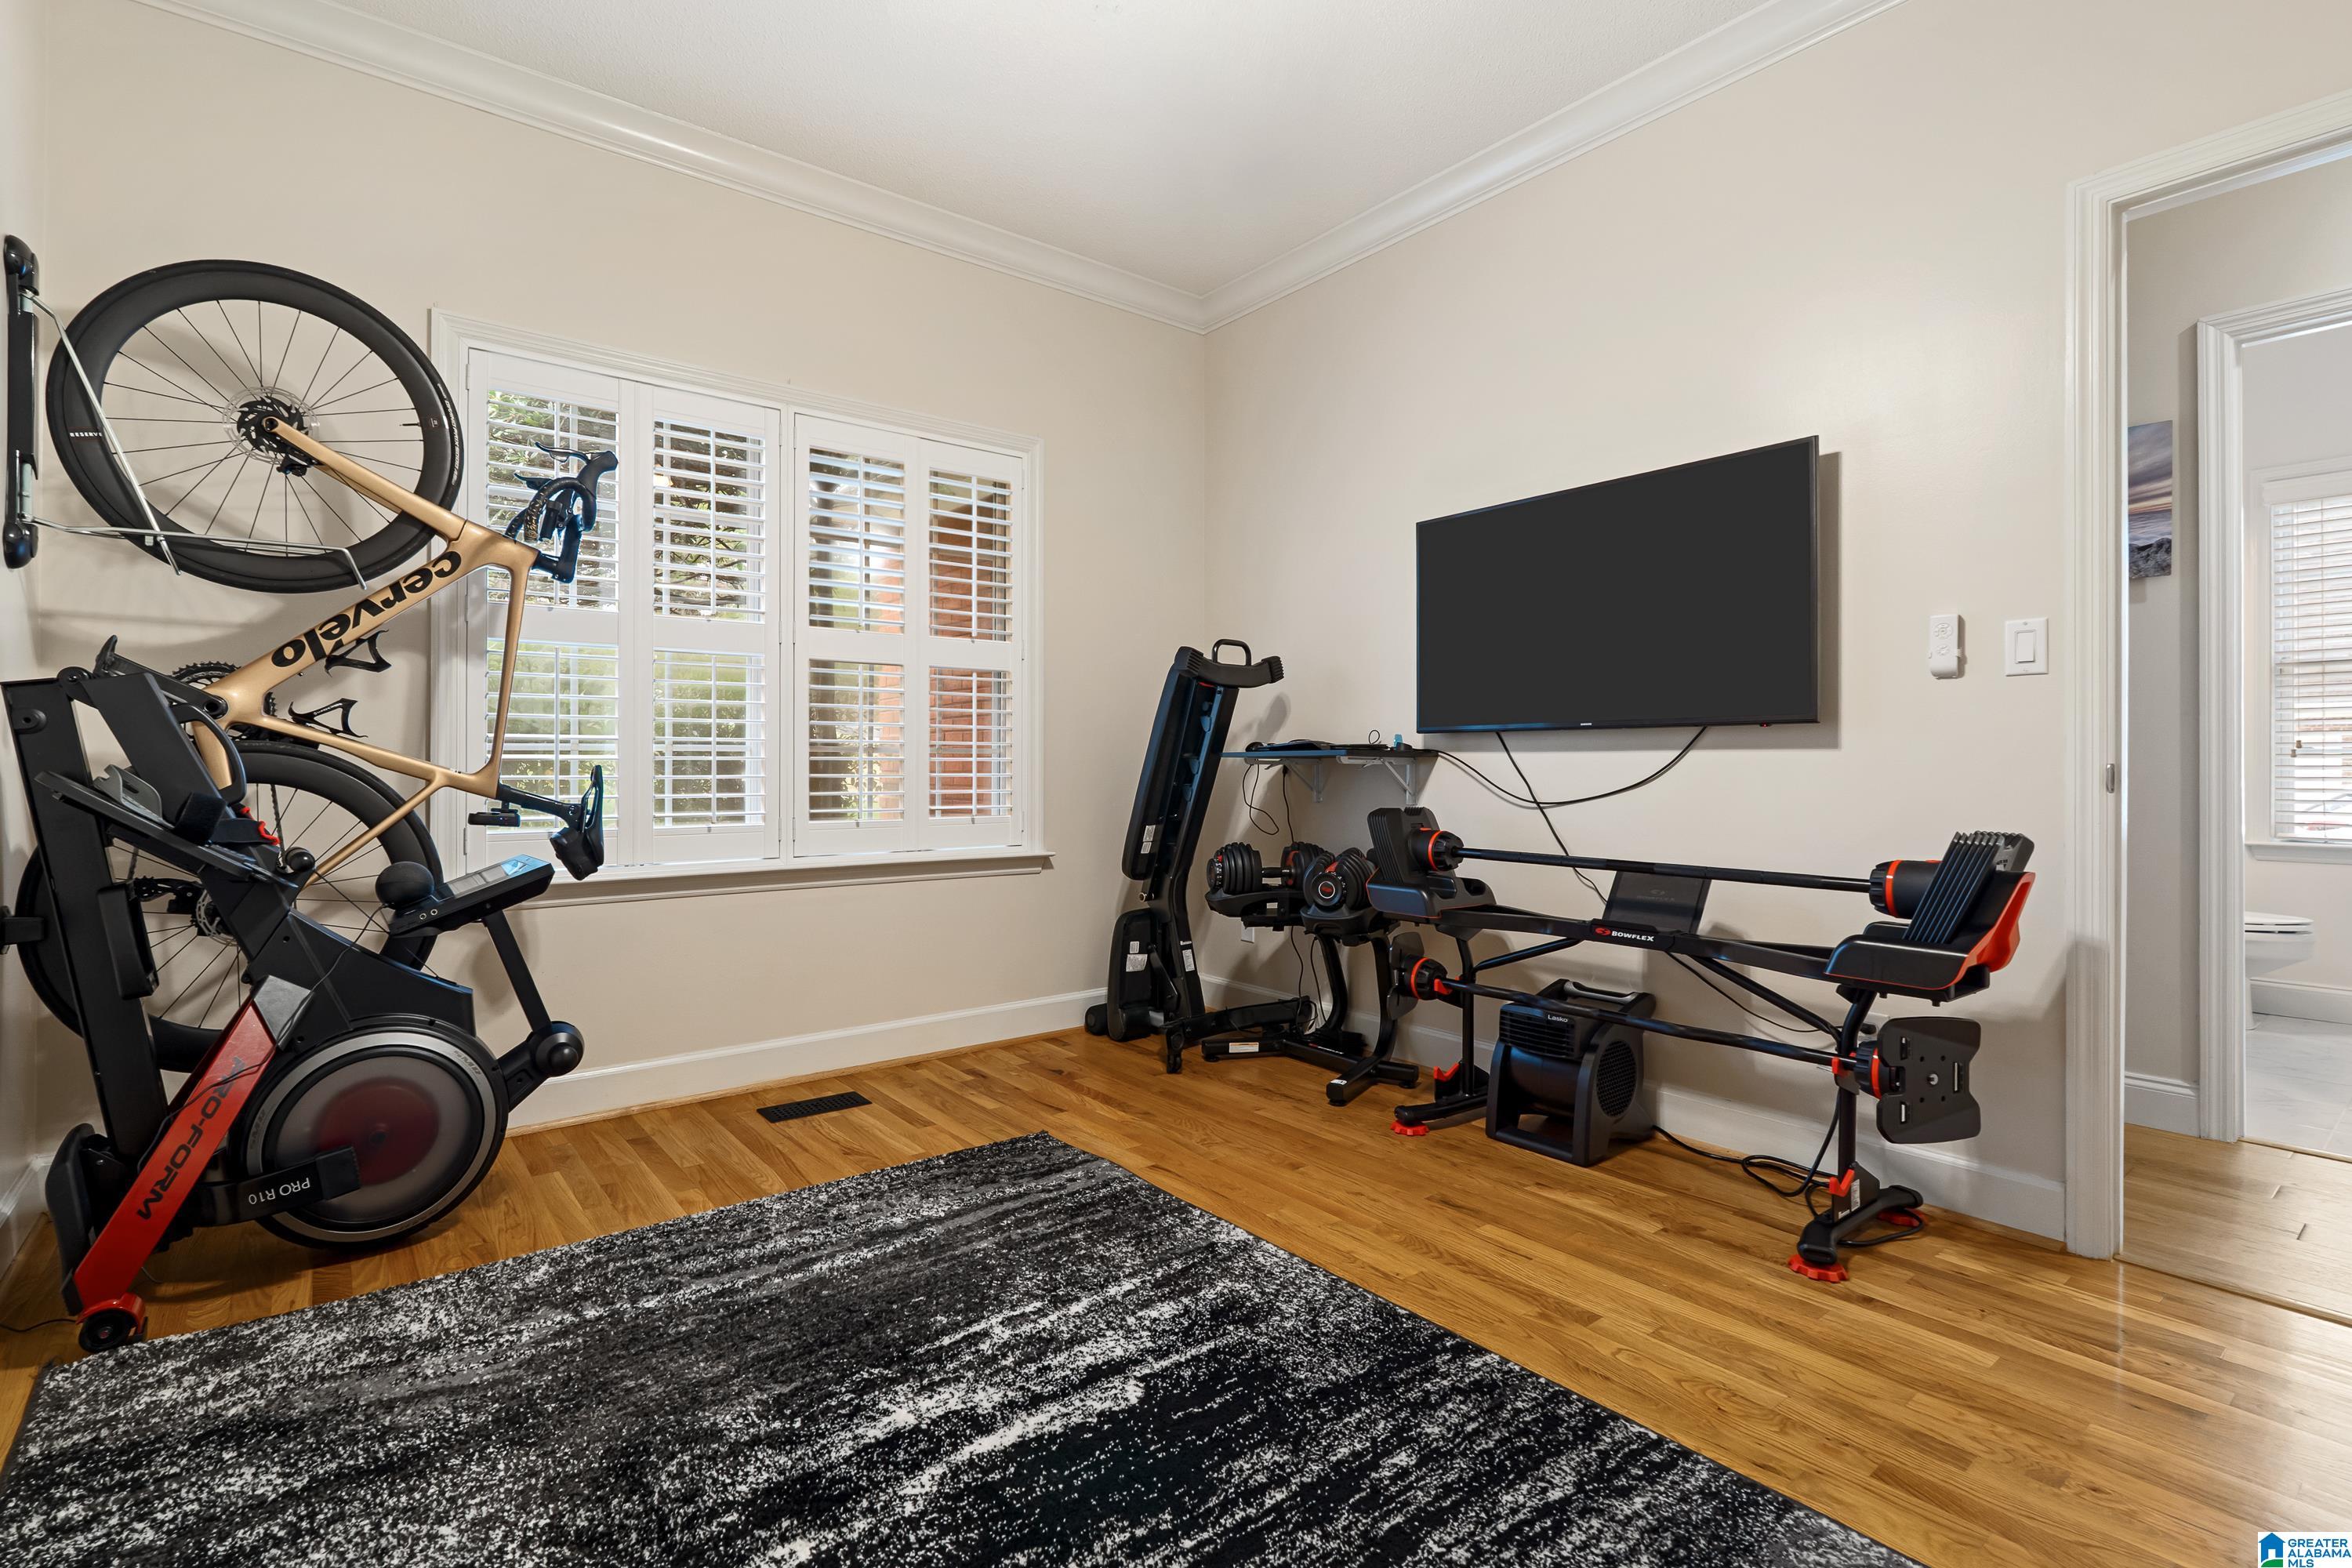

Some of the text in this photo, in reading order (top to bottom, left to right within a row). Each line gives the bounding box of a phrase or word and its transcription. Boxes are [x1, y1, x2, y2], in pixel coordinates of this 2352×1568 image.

[1611, 931, 1655, 942] BOWFLEX
[1548, 1014, 1568, 1022] Lasko
[248, 1177, 310, 1205] PRO R10
